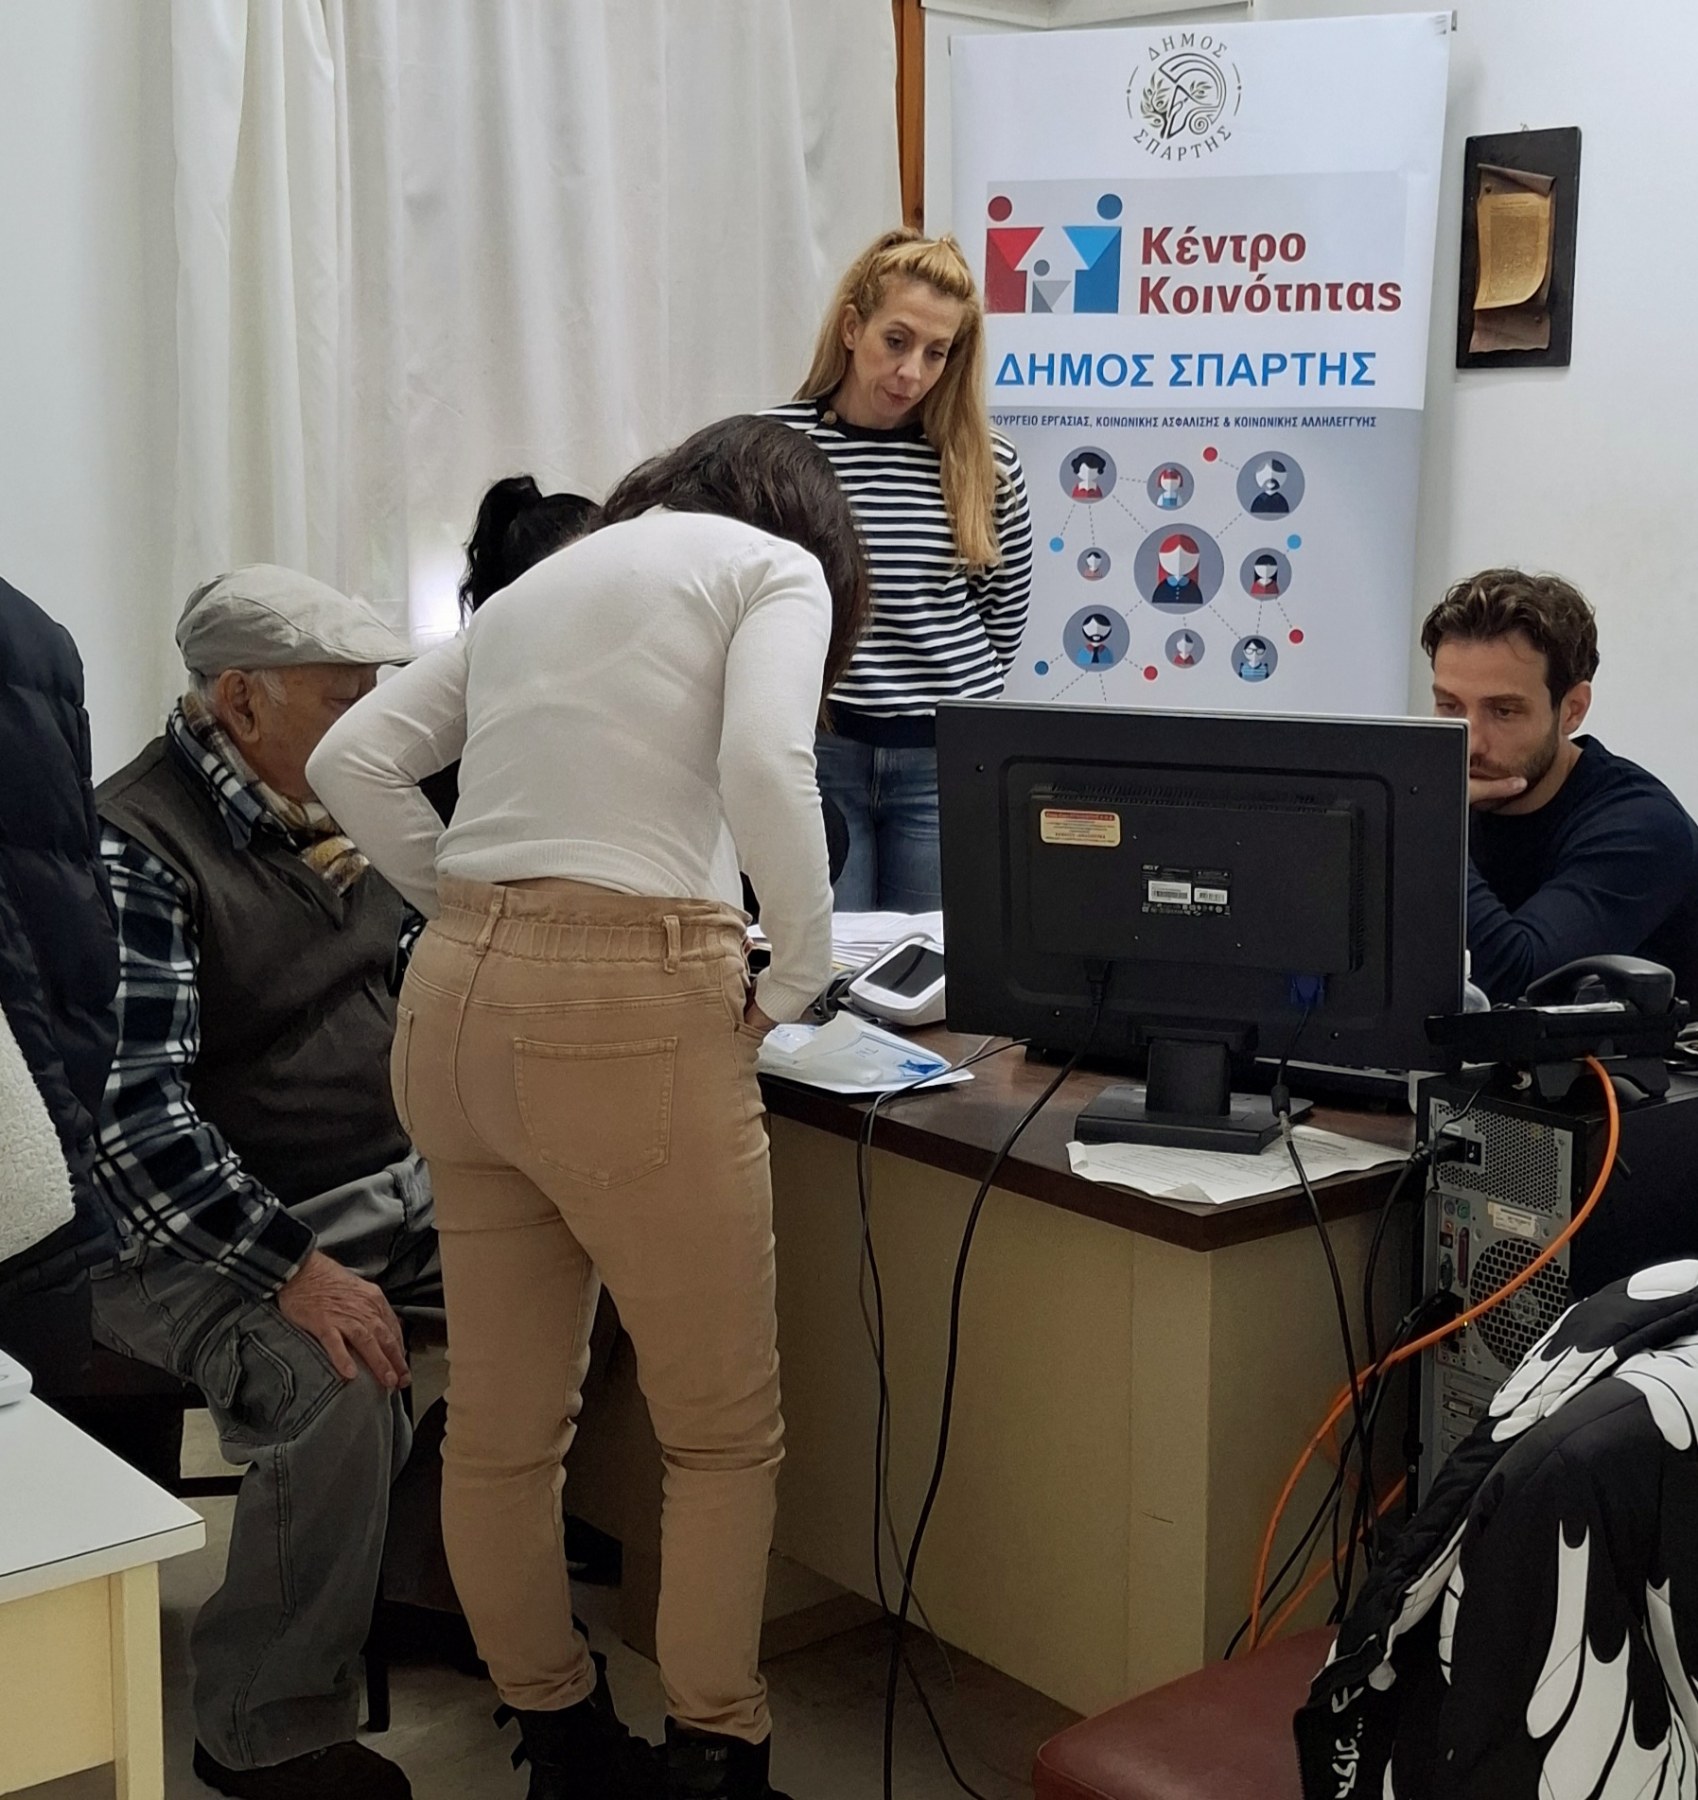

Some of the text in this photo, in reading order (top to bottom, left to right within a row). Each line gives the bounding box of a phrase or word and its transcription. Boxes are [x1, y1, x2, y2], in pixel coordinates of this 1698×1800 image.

[1148, 32, 1228, 61] ΔΗΜΟΣ
[1133, 125, 1232, 162] ΣΠΑΡΤΗΣ
[1141, 225, 1307, 272] Κέντρο
[1139, 273, 1402, 315] Κοινότητας
[995, 352, 1377, 387] ΔΗΜΟΣ ΣΠΑΡΤΗΣ
[1041, 415, 1093, 428] ΕΡΓΑΣΙΑΣ,
[1096, 416, 1159, 428] ΚΟΙΝΩΝΙΚΗΣ
[1161, 416, 1220, 427] ΑΣΦΑΛΙΣΗΣ
[1223, 416, 1231, 427] &
[1234, 416, 1298, 428] ΚΟΙΝΩΝΙΚΗΣ
[1301, 415, 1377, 427] ΑΛΛΗΛΕΓΓΥΗΣ
